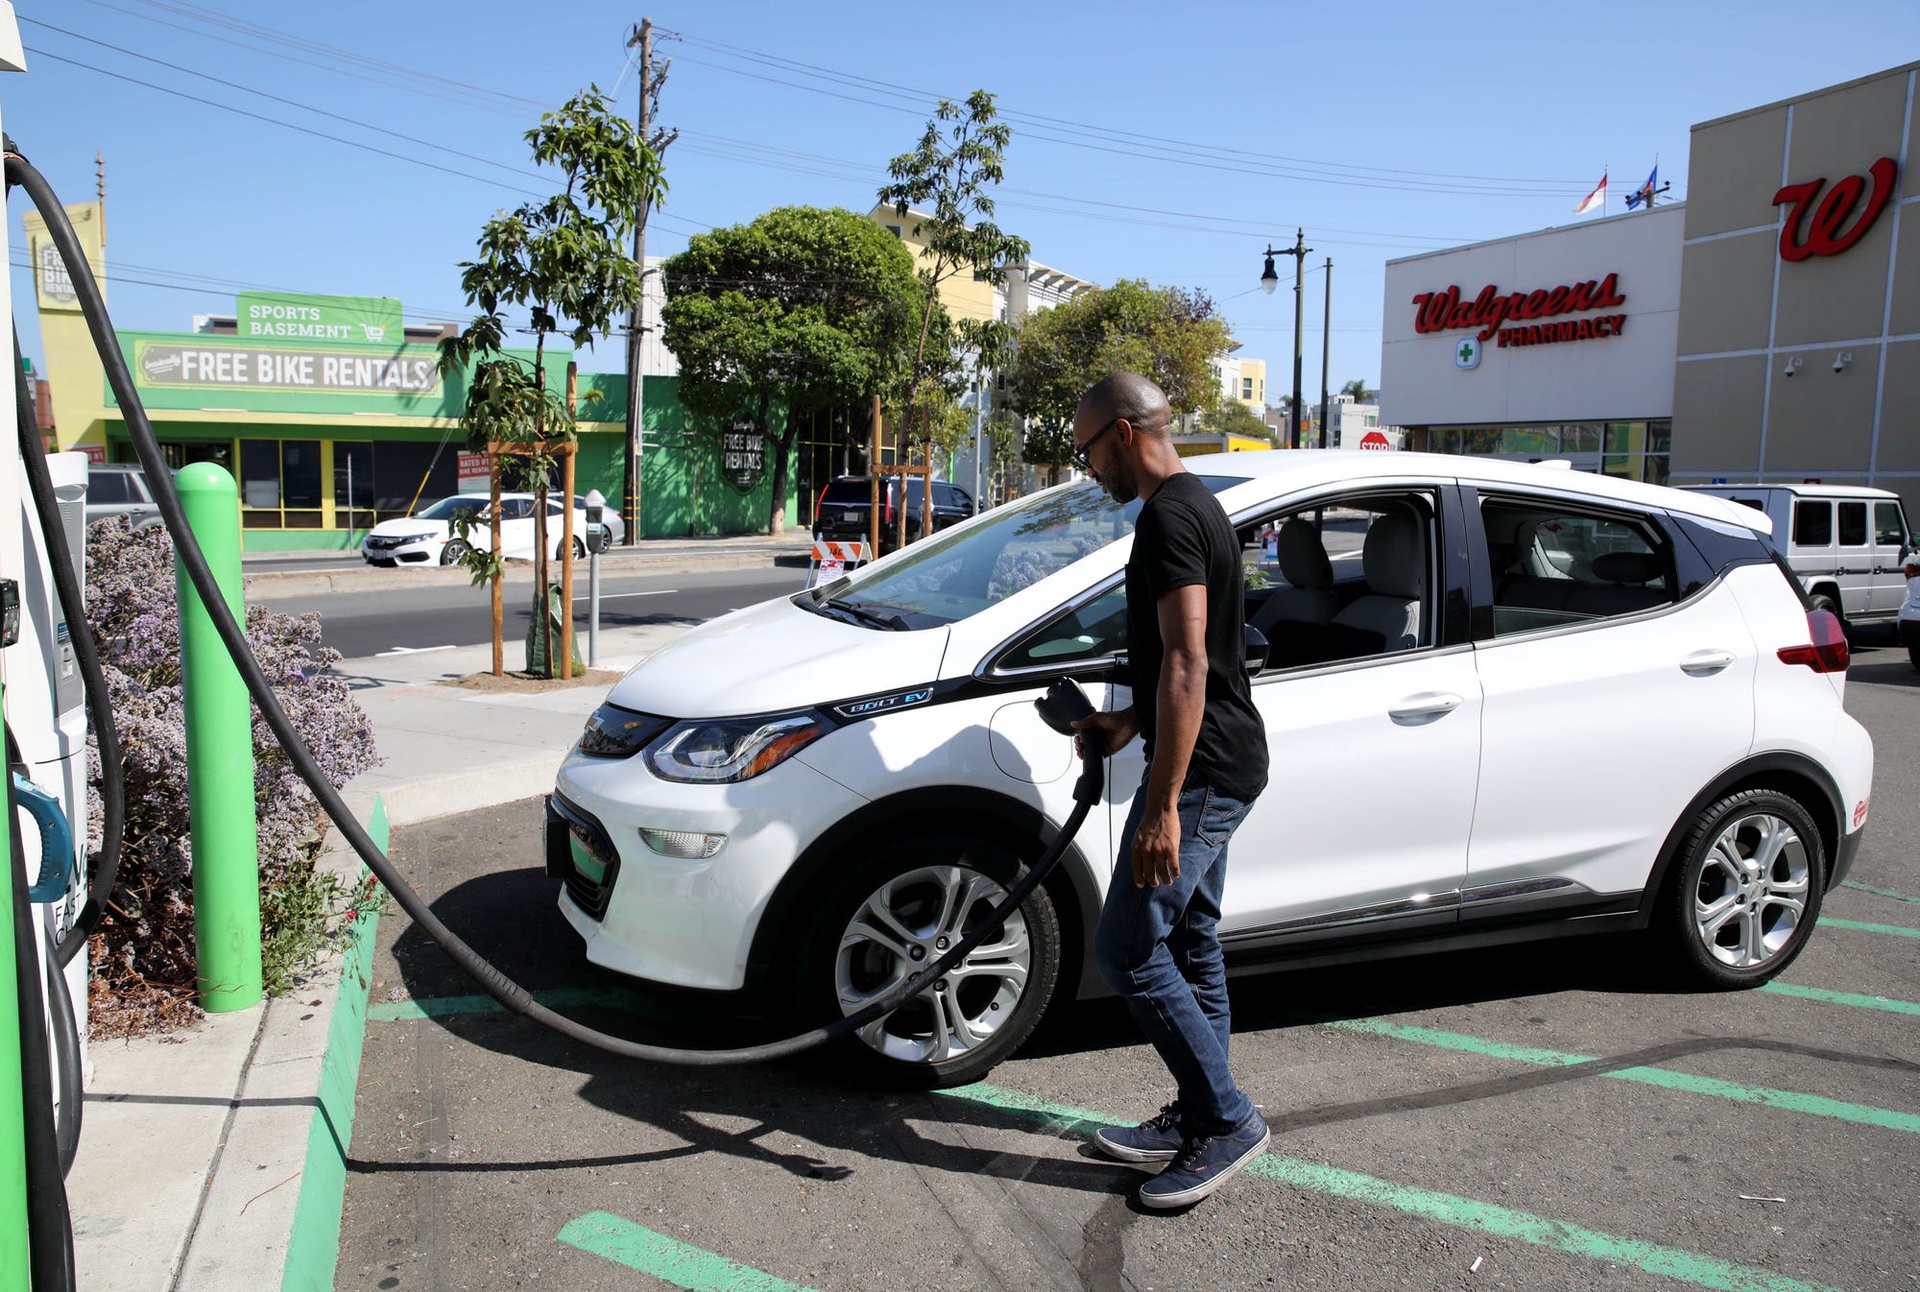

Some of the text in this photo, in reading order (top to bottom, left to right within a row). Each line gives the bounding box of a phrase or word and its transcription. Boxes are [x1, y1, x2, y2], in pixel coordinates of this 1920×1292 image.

[43, 249, 63, 267] FR
[250, 305, 320, 321] SPORTS
[1412, 273, 1626, 342] Walgreens
[250, 321, 351, 339] BASEMENT
[1497, 314, 1626, 348] PHARMACY
[181, 351, 248, 382] FREE
[257, 354, 314, 385] BIKE
[323, 360, 429, 389] RENTALS
[723, 433, 765, 451] FREE BIKE
[1362, 442, 1388, 452] STOP
[725, 452, 762, 470] RENTALS
[850, 691, 927, 713] BOLT EV
[56, 893, 81, 925] FAST
